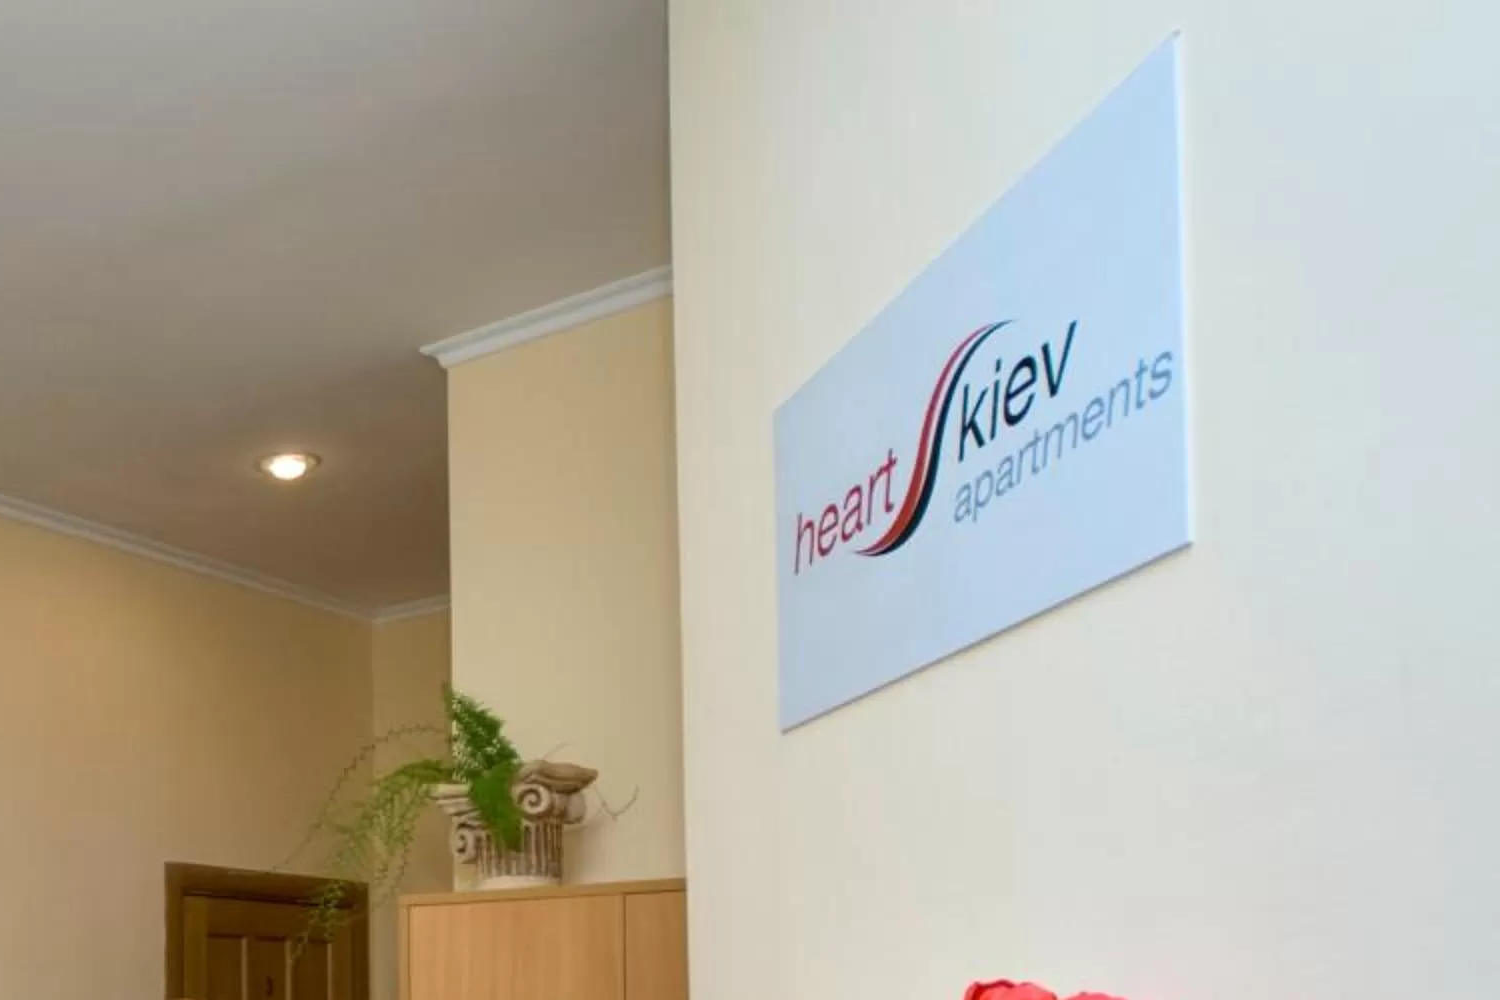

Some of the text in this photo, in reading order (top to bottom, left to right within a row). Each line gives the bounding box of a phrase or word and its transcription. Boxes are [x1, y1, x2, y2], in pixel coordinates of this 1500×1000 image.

[794, 320, 1077, 576] heart kiev
[953, 350, 1174, 524] apartments
